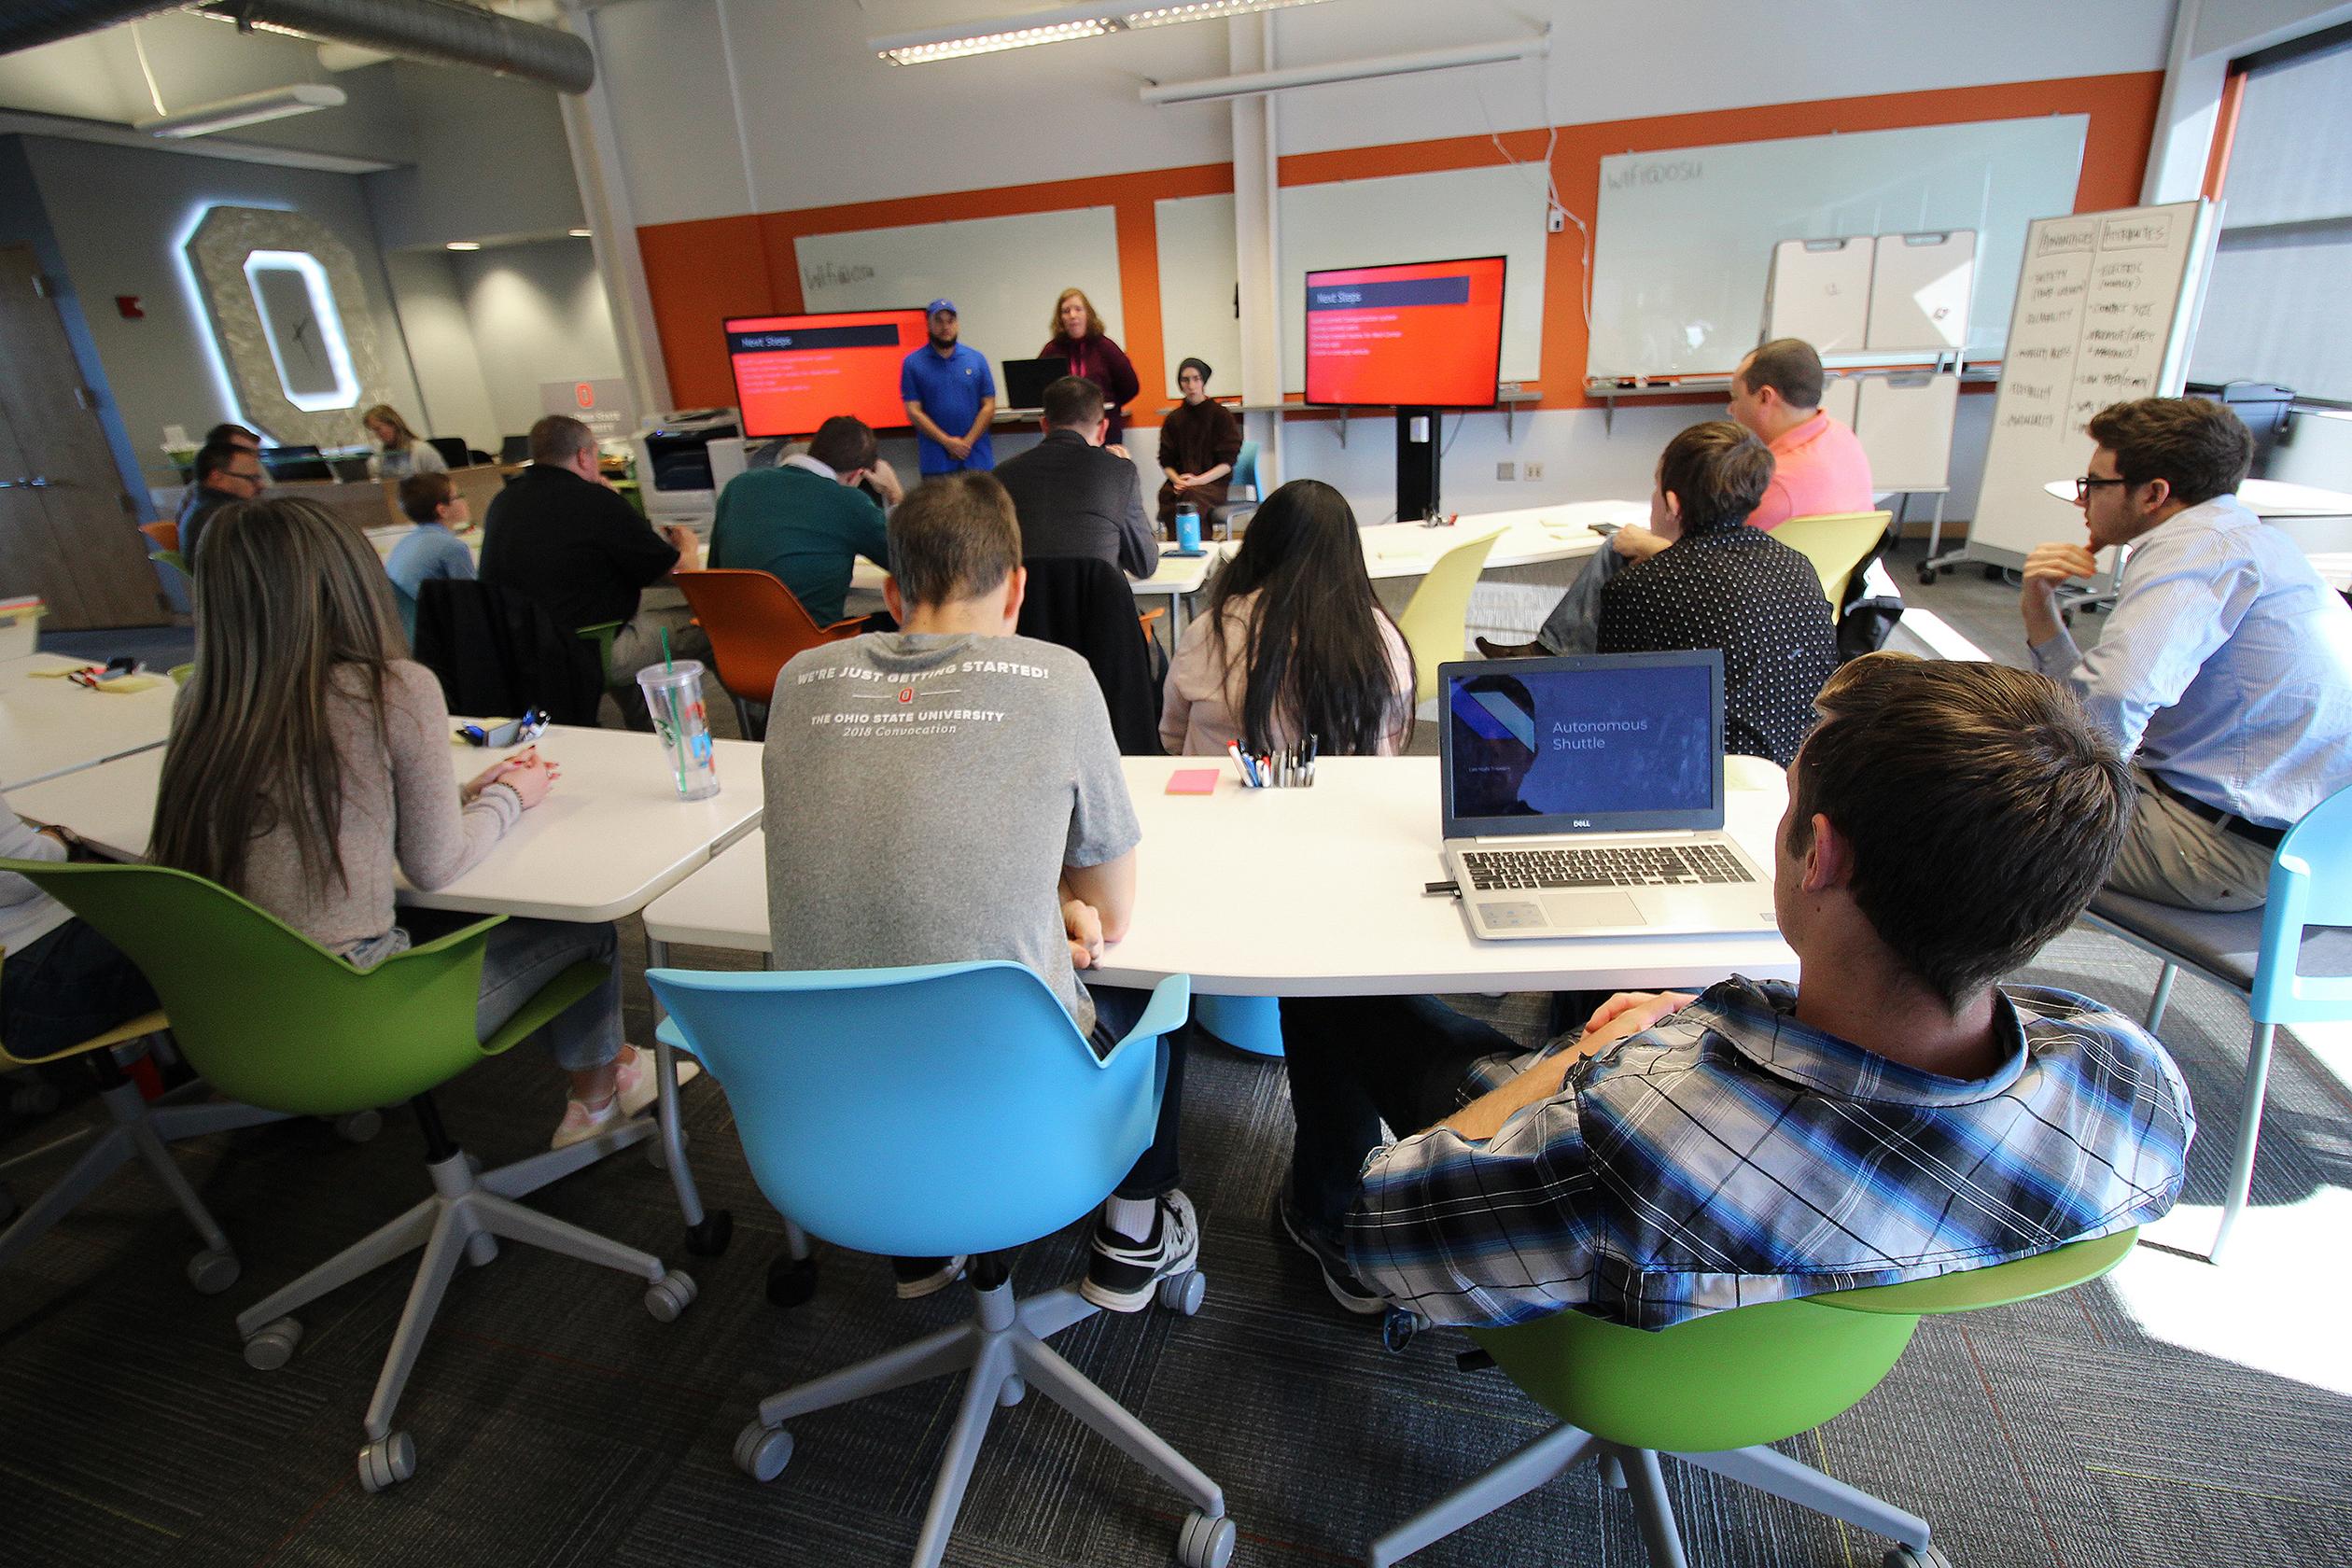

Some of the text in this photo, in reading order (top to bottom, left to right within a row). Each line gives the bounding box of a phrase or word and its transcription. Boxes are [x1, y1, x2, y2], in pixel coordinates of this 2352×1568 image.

[1317, 290, 1362, 305] Next Steps
[741, 335, 791, 349] Next Steps
[798, 661, 1049, 685] WE'RE JUST GETTING STARTED!
[811, 709, 1005, 725] THE OHIO STATE UNIVERSITY
[843, 723, 957, 737] 2018 Convocation
[1552, 720, 1648, 734] Autonomous
[1552, 736, 1605, 750] Shuttle
[1573, 819, 1590, 828] DELL
